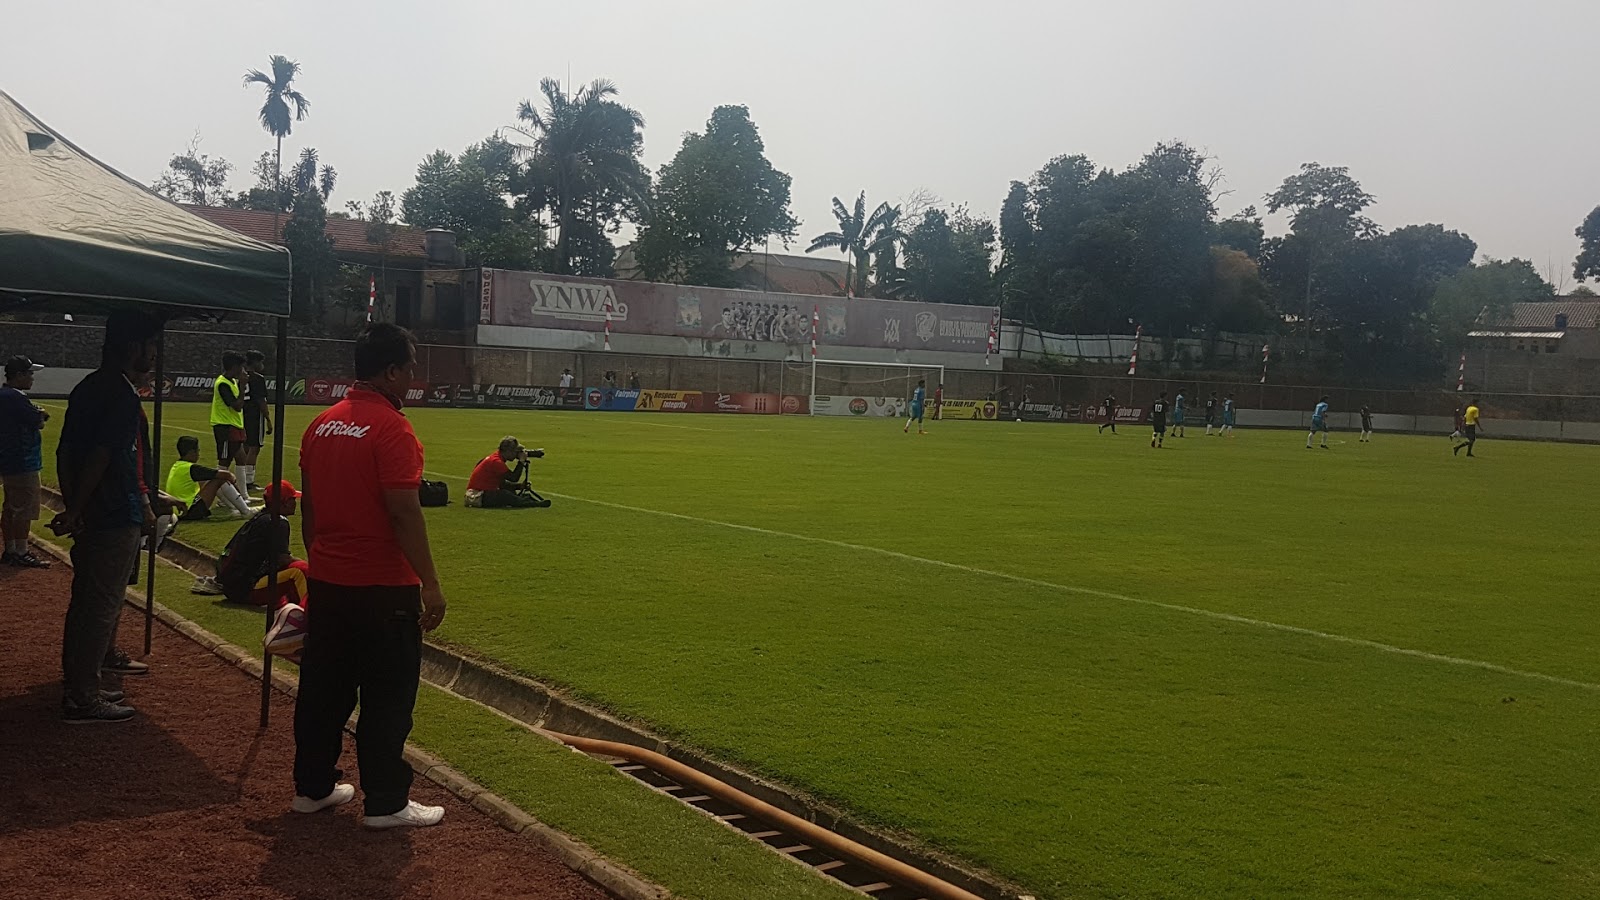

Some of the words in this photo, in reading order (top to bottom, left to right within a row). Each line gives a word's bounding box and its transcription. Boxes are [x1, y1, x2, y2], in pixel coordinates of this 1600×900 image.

[615, 389, 639, 399] Fairplay
[654, 391, 678, 399] Respect
[533, 395, 555, 405] 2018
[662, 400, 688, 409] Integrity
[1154, 403, 1163, 413] 10
[315, 420, 370, 438] official
